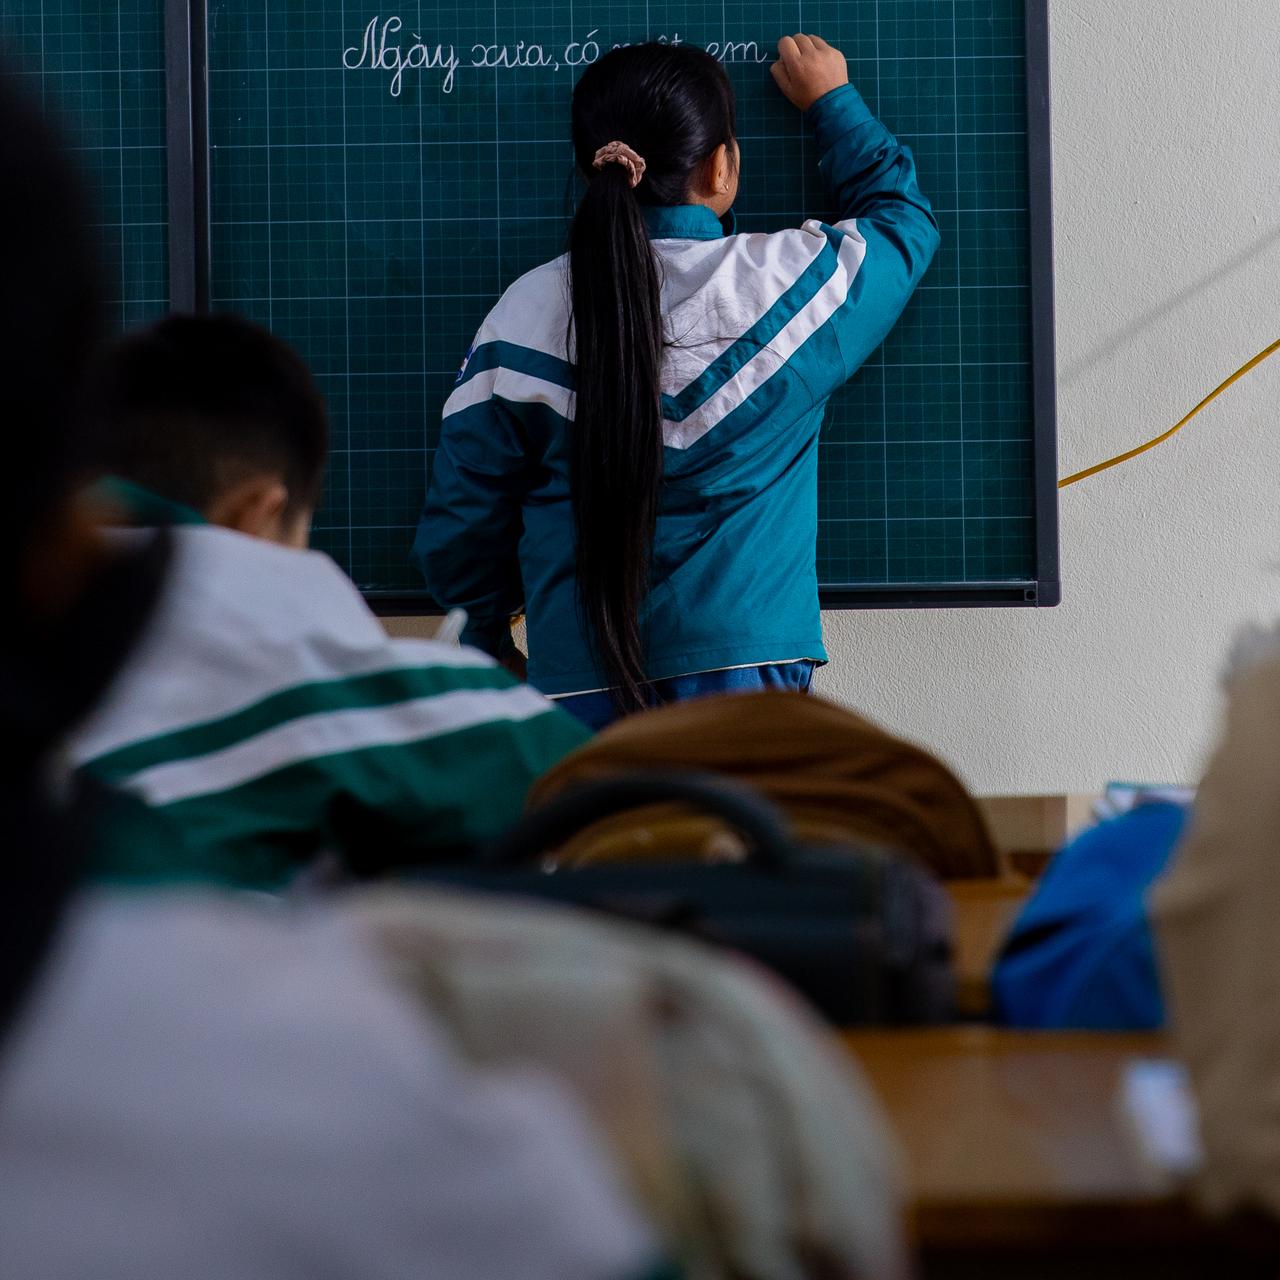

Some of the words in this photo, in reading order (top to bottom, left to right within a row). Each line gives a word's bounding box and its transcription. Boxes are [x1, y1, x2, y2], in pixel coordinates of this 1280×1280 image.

[340, 13, 461, 98] Ngày
[469, 40, 561, 71] xưa,
[563, 27, 601, 67] có
